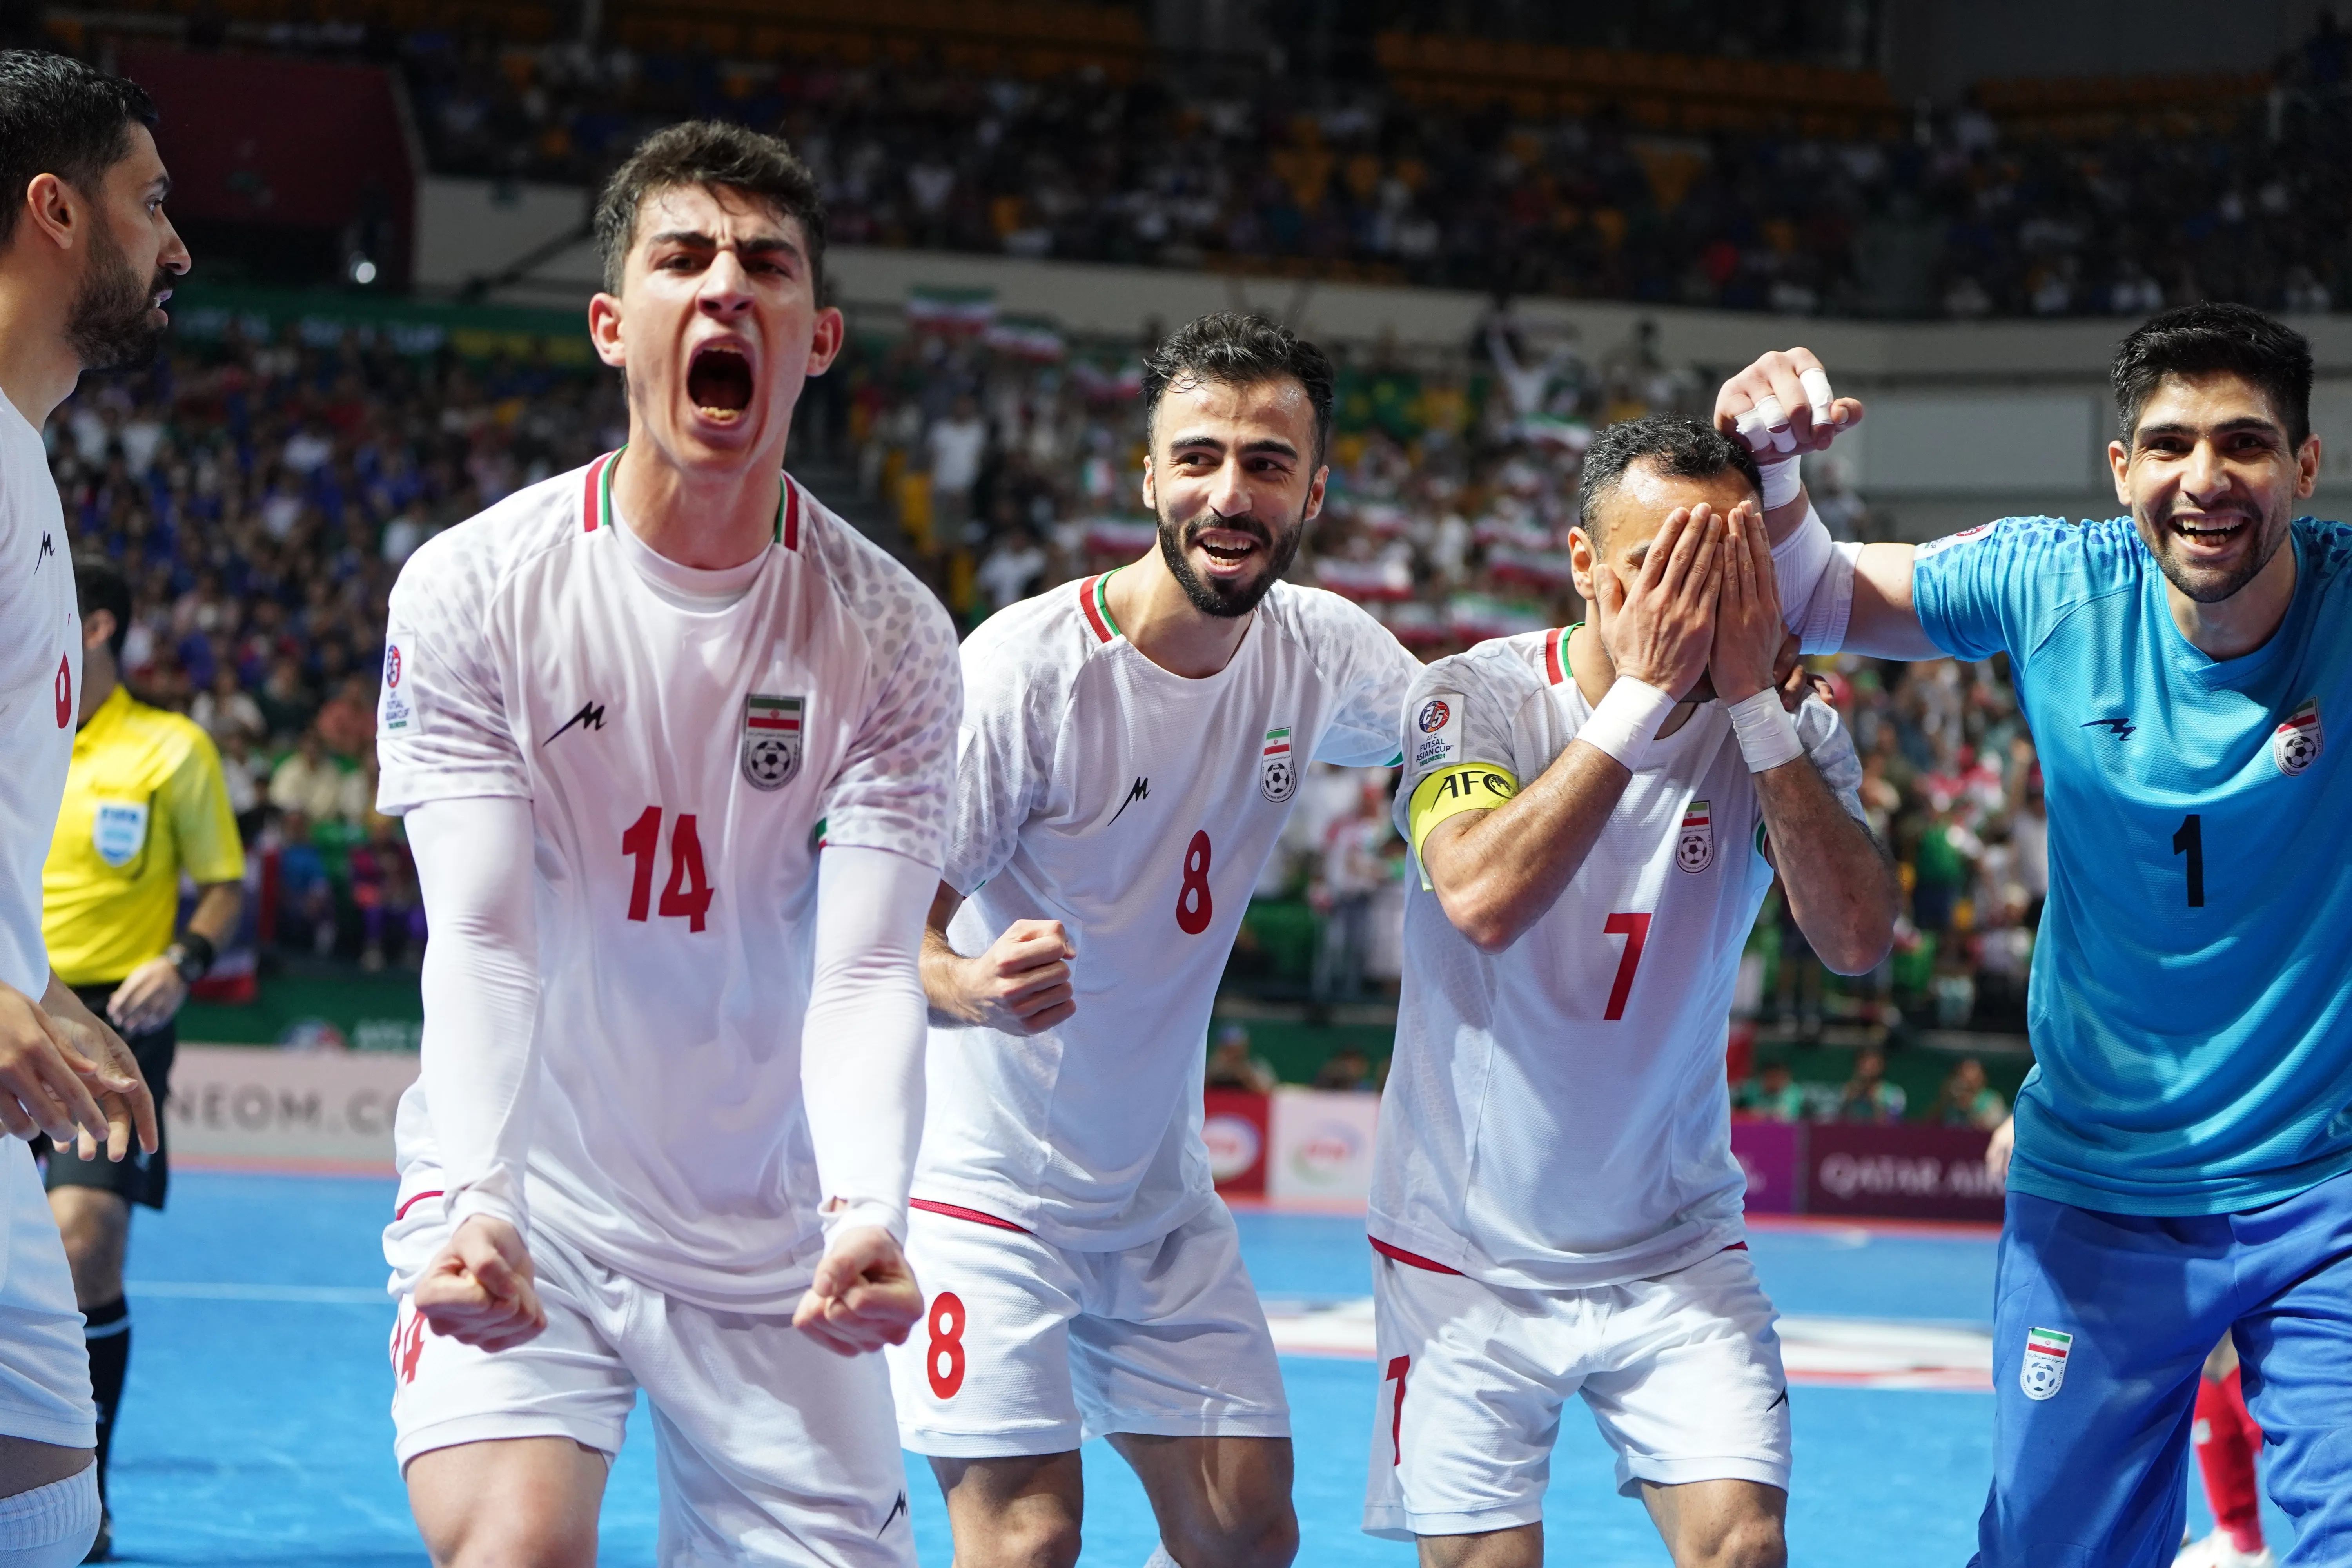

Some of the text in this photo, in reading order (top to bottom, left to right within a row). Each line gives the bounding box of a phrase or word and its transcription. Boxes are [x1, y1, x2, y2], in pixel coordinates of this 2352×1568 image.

[1416, 748, 1434, 762] ASIAN
[1420, 739, 1445, 752] FUTSAL
[1426, 733, 1437, 742] AFC
[1430, 771, 1515, 813] AFC
[622, 805, 715, 933] 14
[1176, 830, 1212, 935] 8
[2173, 814, 2204, 907] 1
[1603, 913, 1652, 1020] 7
[168, 1083, 400, 1136] NEOM.C
[927, 1292, 966, 1399] 8
[1386, 1354, 1410, 1467] 7
